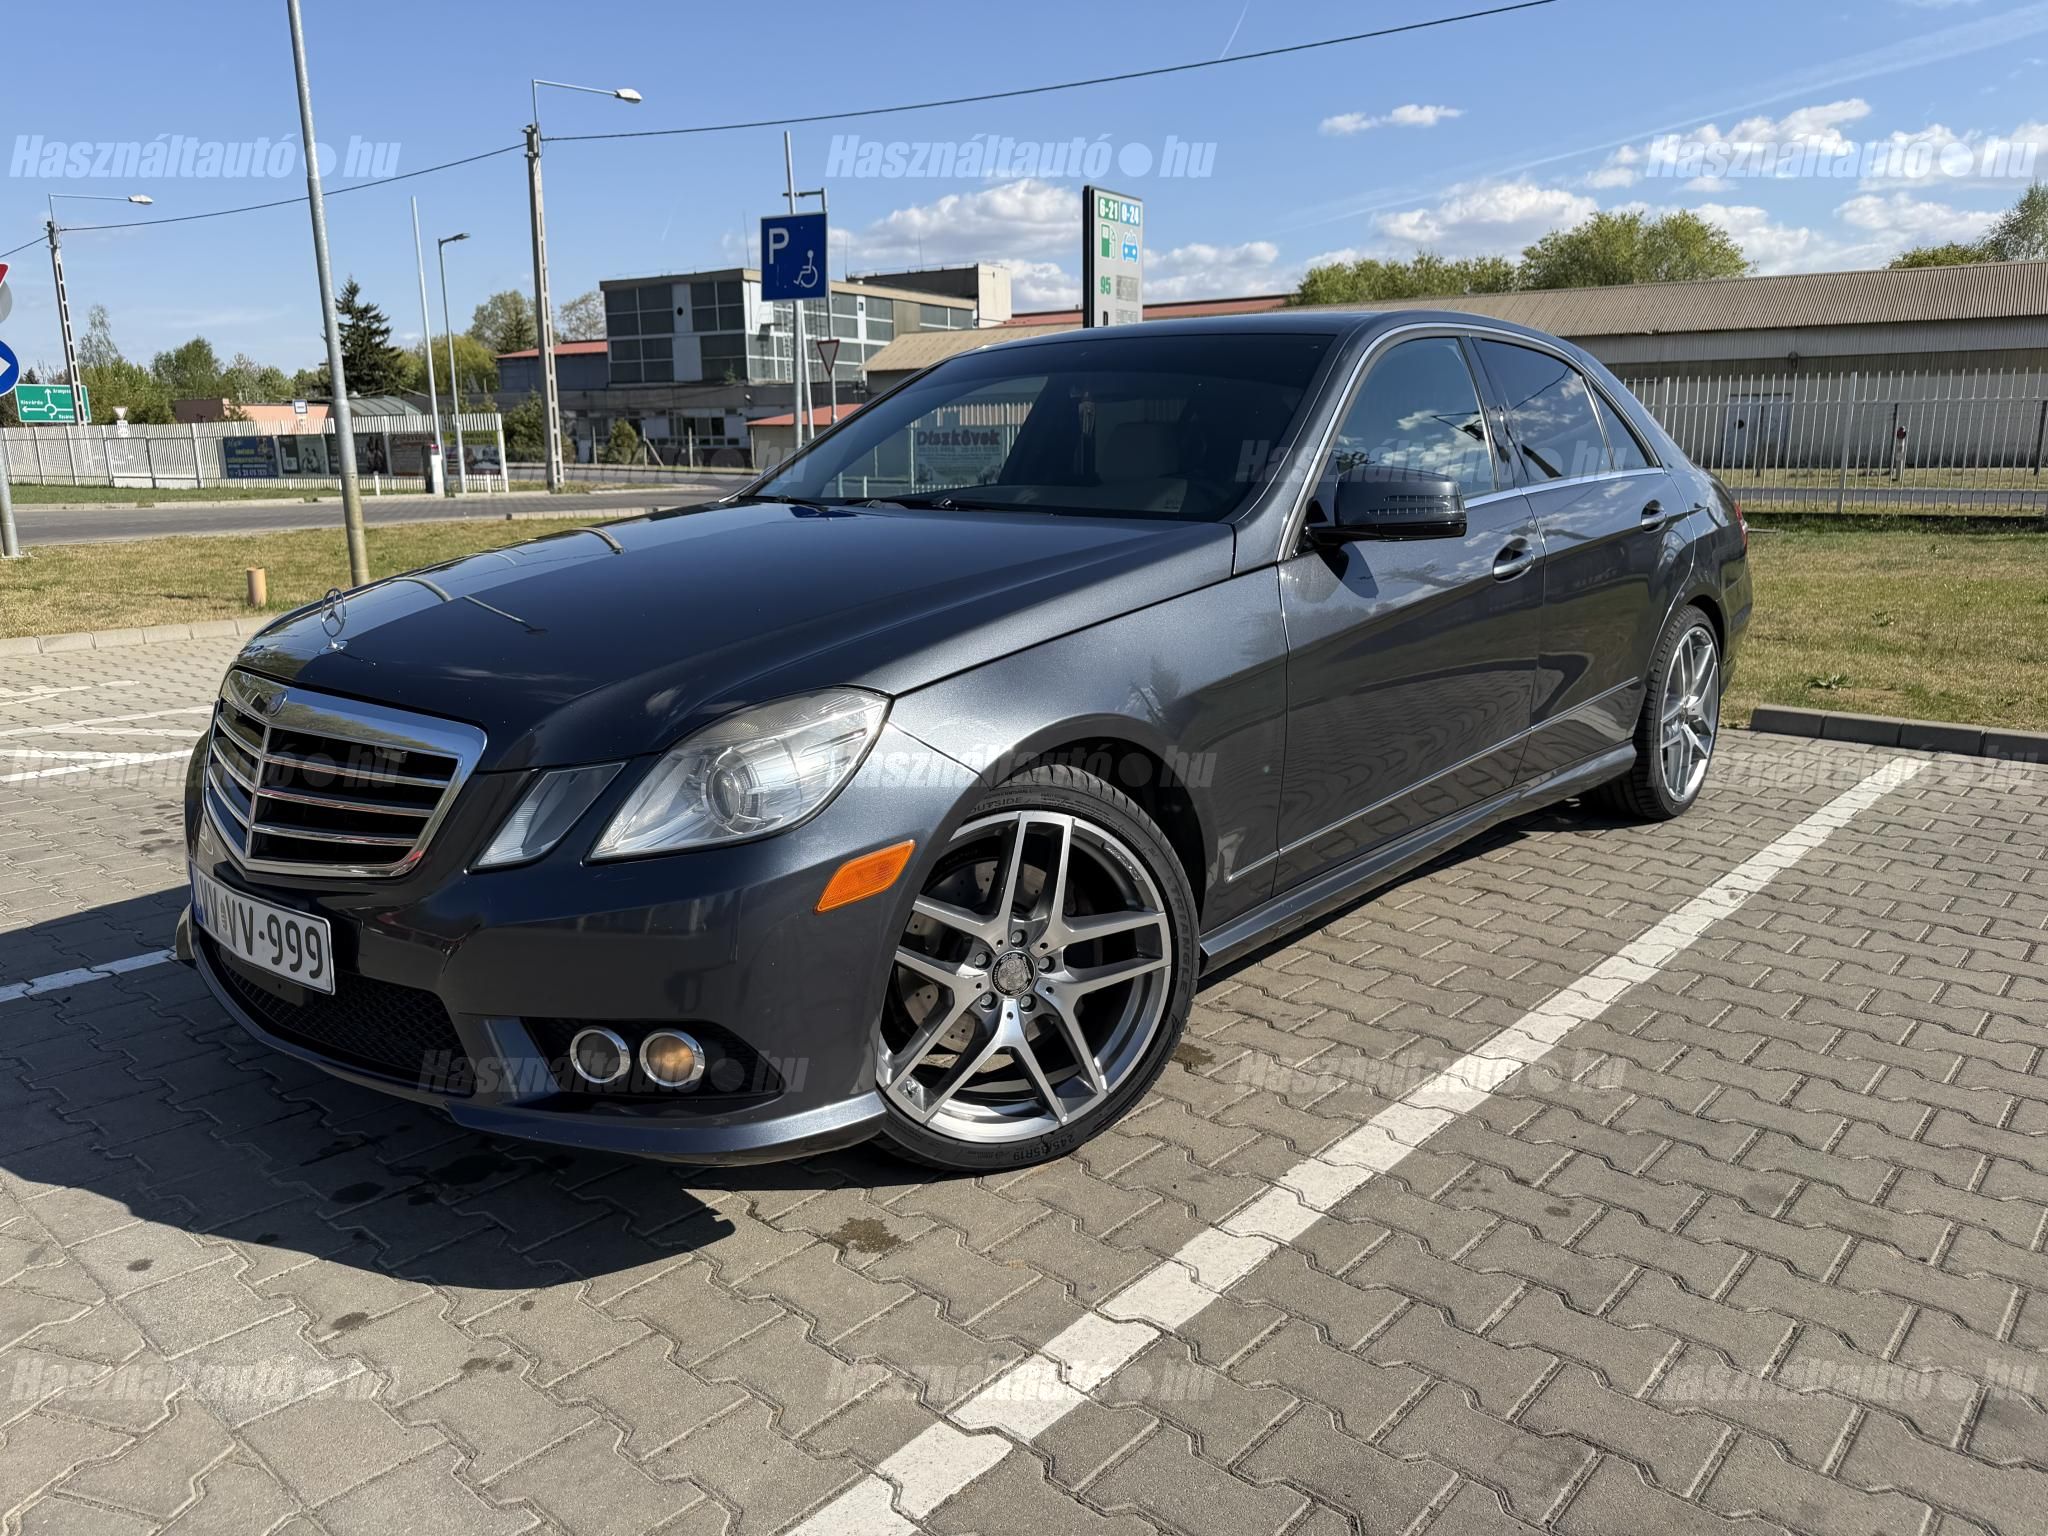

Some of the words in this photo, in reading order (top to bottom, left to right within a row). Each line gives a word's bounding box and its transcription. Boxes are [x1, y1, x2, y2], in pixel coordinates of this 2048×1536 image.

[1099, 198, 1119, 217] 6-21
[1121, 204, 1140, 224] 0-24
[769, 228, 789, 264] P
[1100, 275, 1111, 294] 95
[225, 894, 324, 979] VV-999
